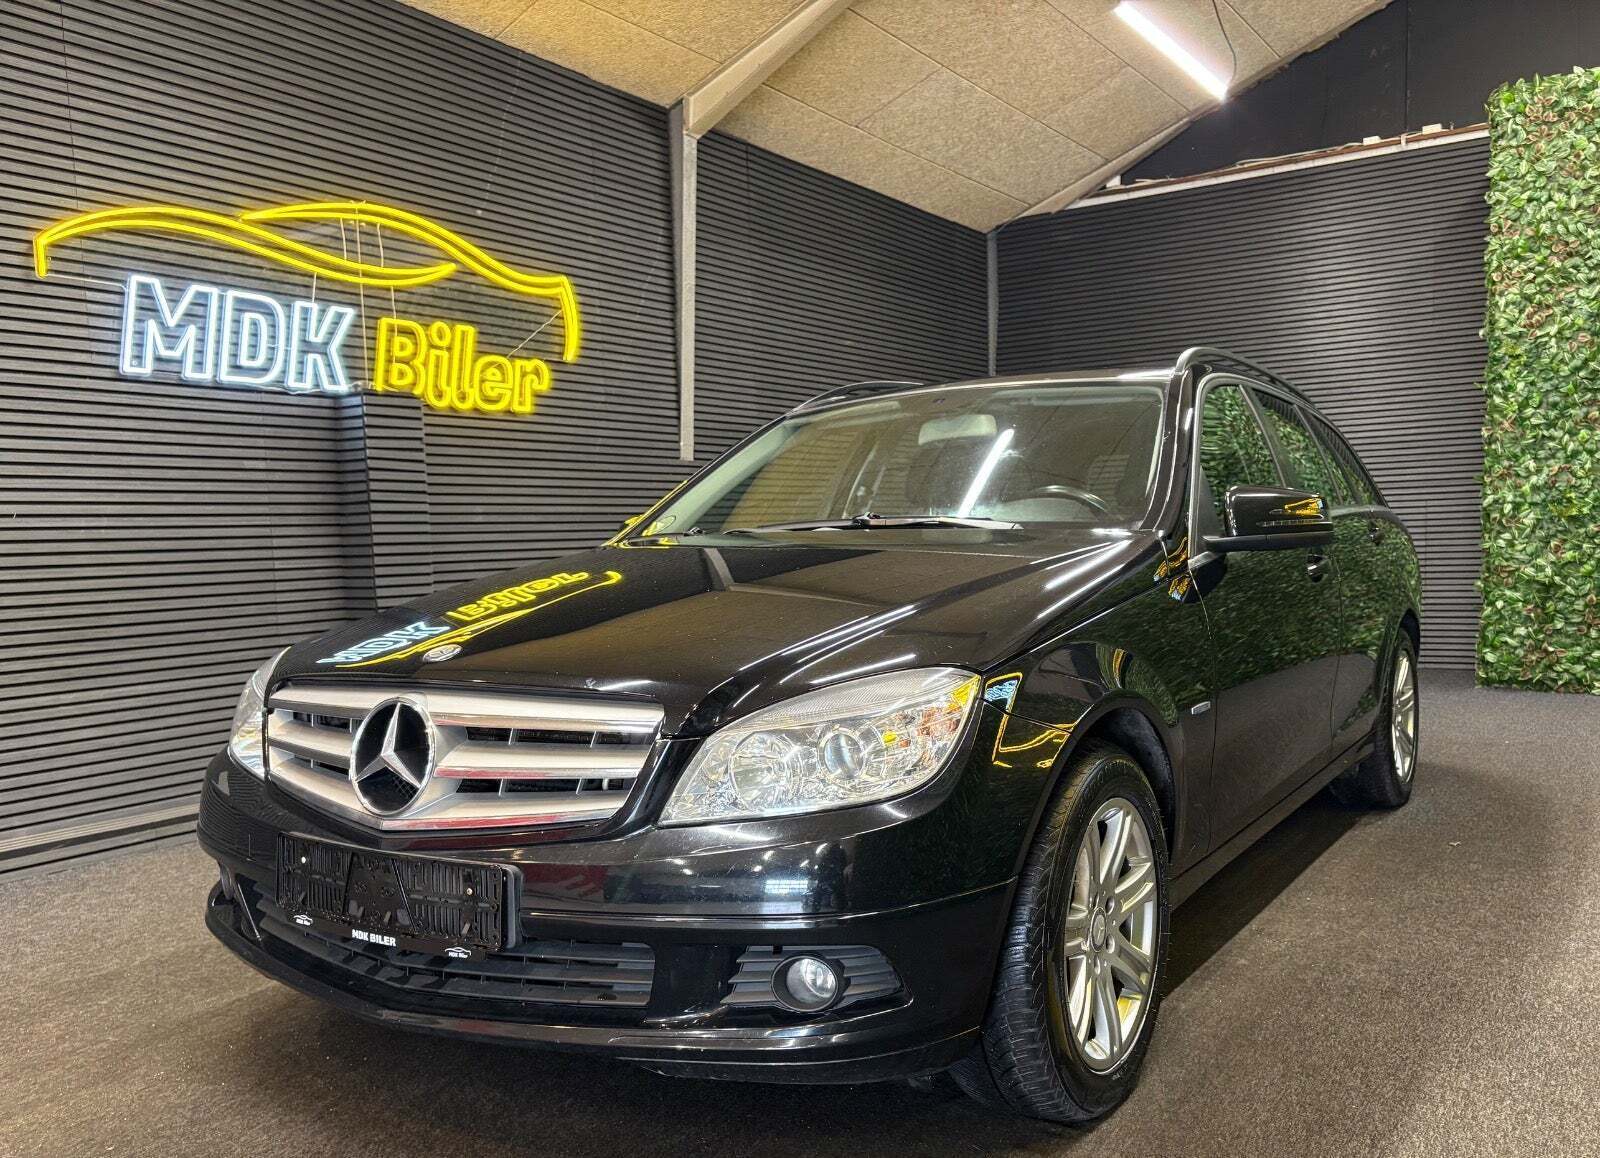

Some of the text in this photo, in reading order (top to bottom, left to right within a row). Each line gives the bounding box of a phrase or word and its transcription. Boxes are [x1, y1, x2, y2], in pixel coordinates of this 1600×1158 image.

[120, 273, 552, 415] MDK Biler
[351, 929, 396, 947] MDK BILER
